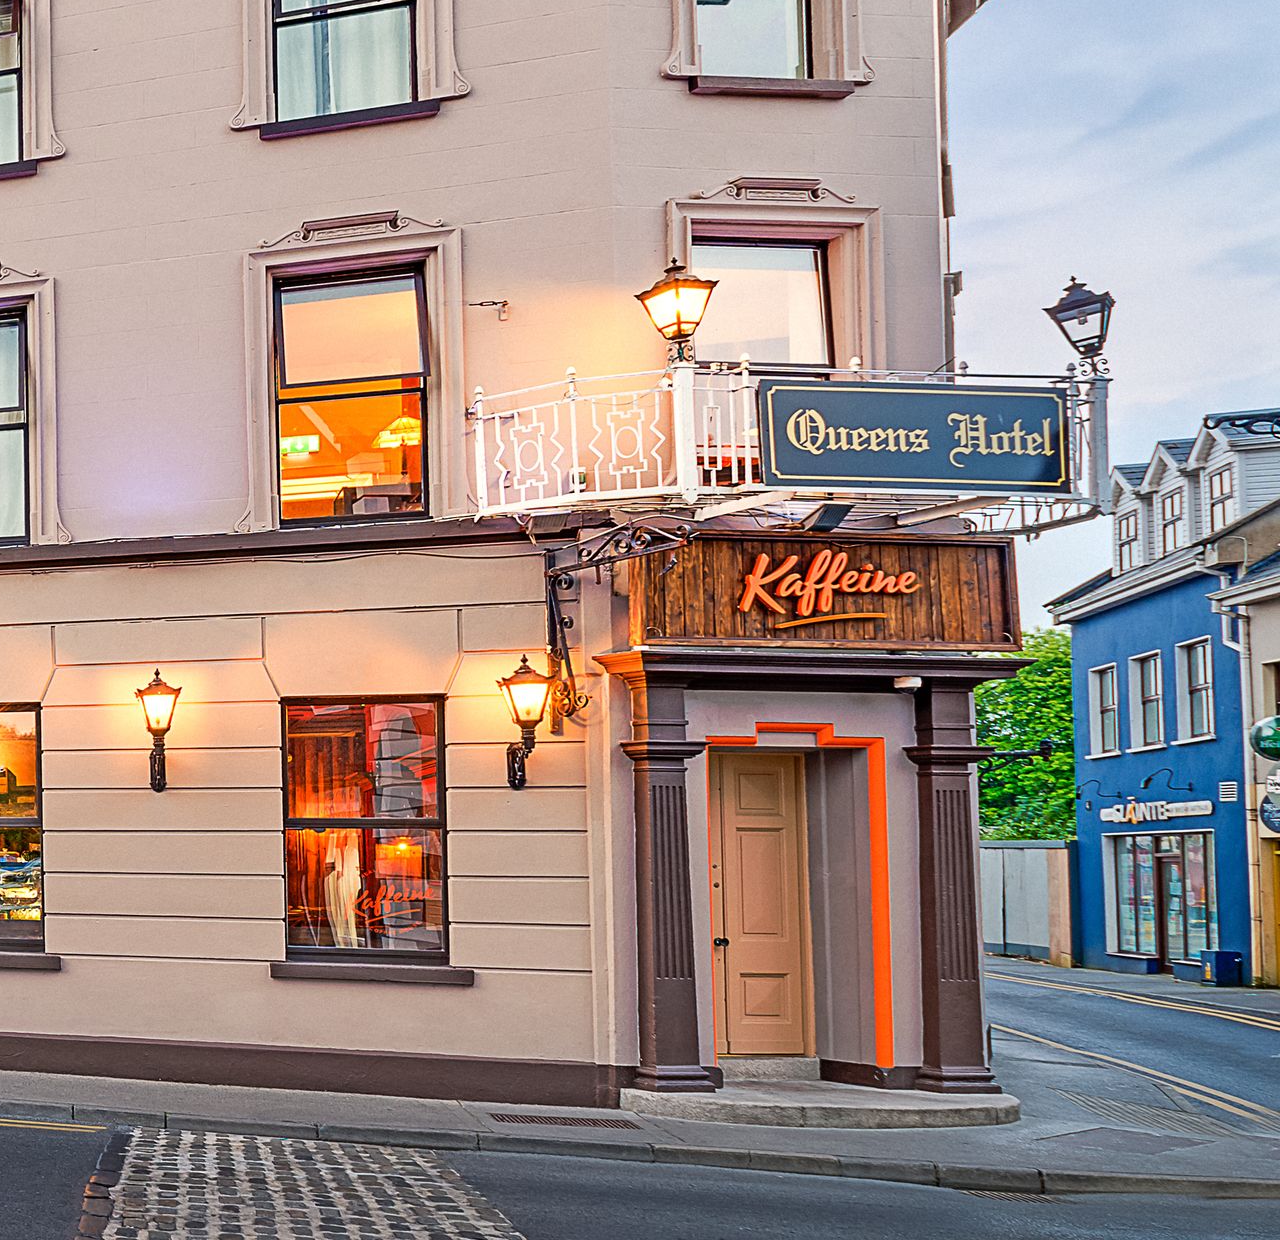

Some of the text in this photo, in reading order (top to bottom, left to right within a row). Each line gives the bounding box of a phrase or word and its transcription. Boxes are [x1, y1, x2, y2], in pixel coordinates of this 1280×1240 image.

[786, 409, 1055, 468] Queens Hotel
[739, 549, 923, 616] Kaffeine
